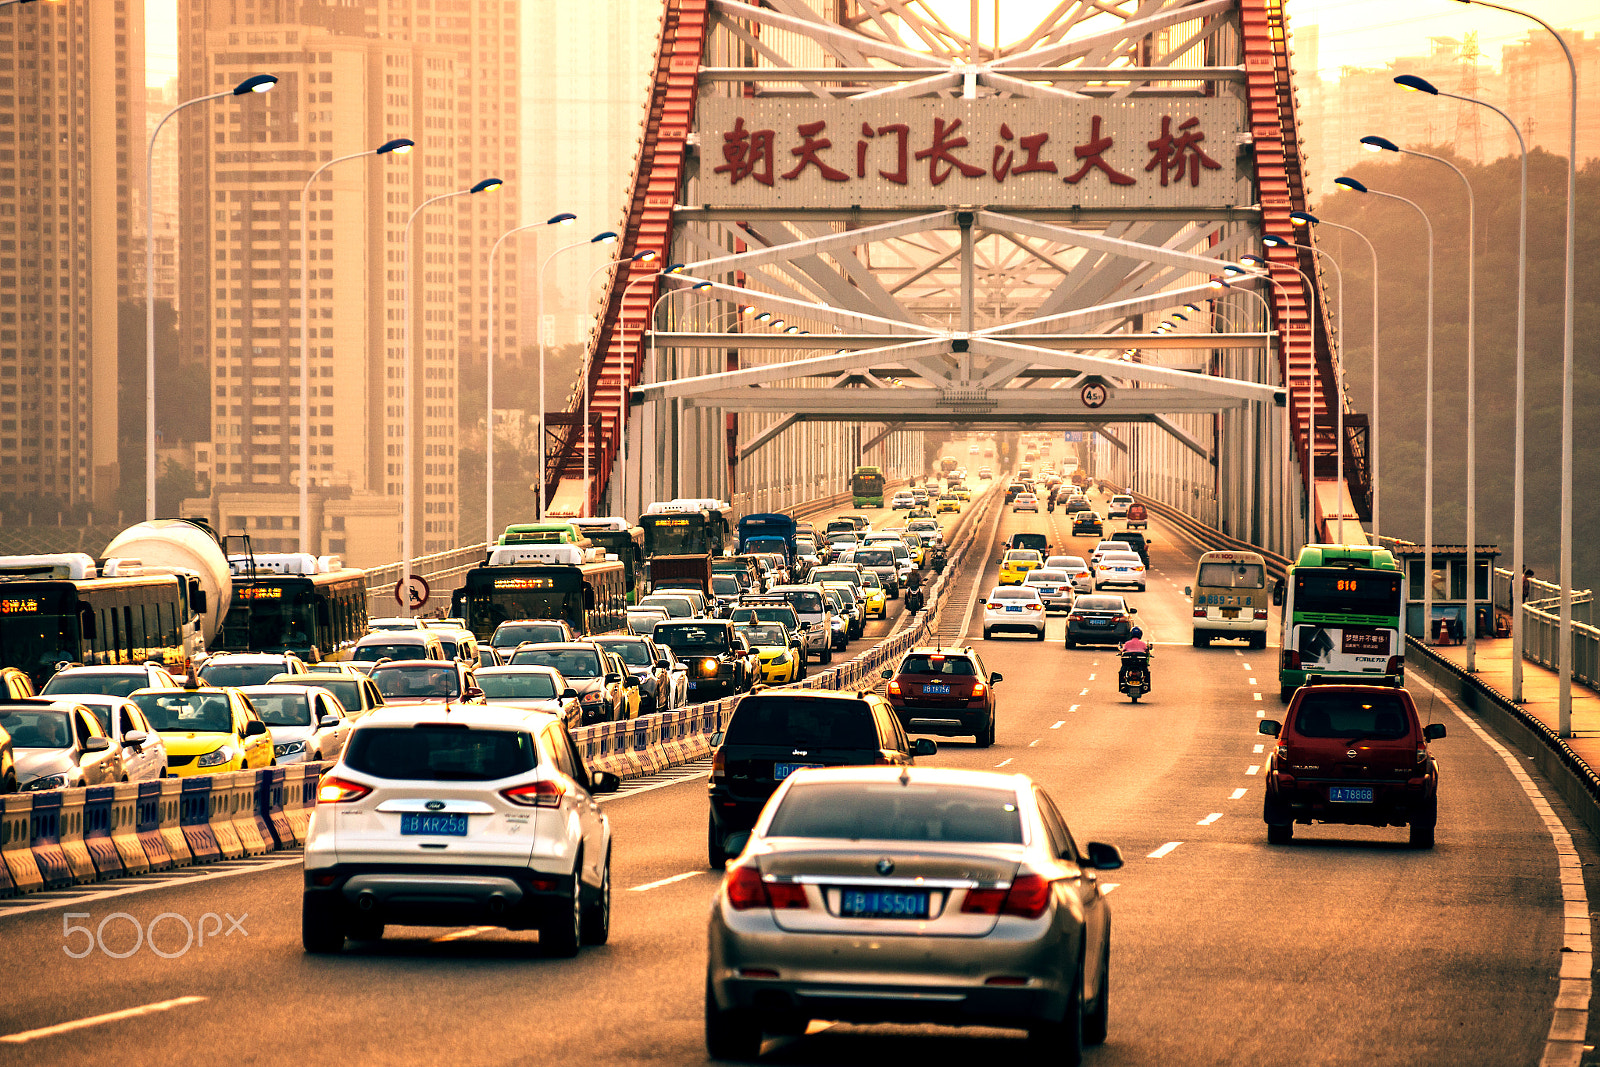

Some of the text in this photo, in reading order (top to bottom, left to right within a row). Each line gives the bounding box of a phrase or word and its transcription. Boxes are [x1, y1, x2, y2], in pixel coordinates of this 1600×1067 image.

[714, 115, 1222, 187] 朝天门长江大桥
[792, 749, 808, 757] Jeep
